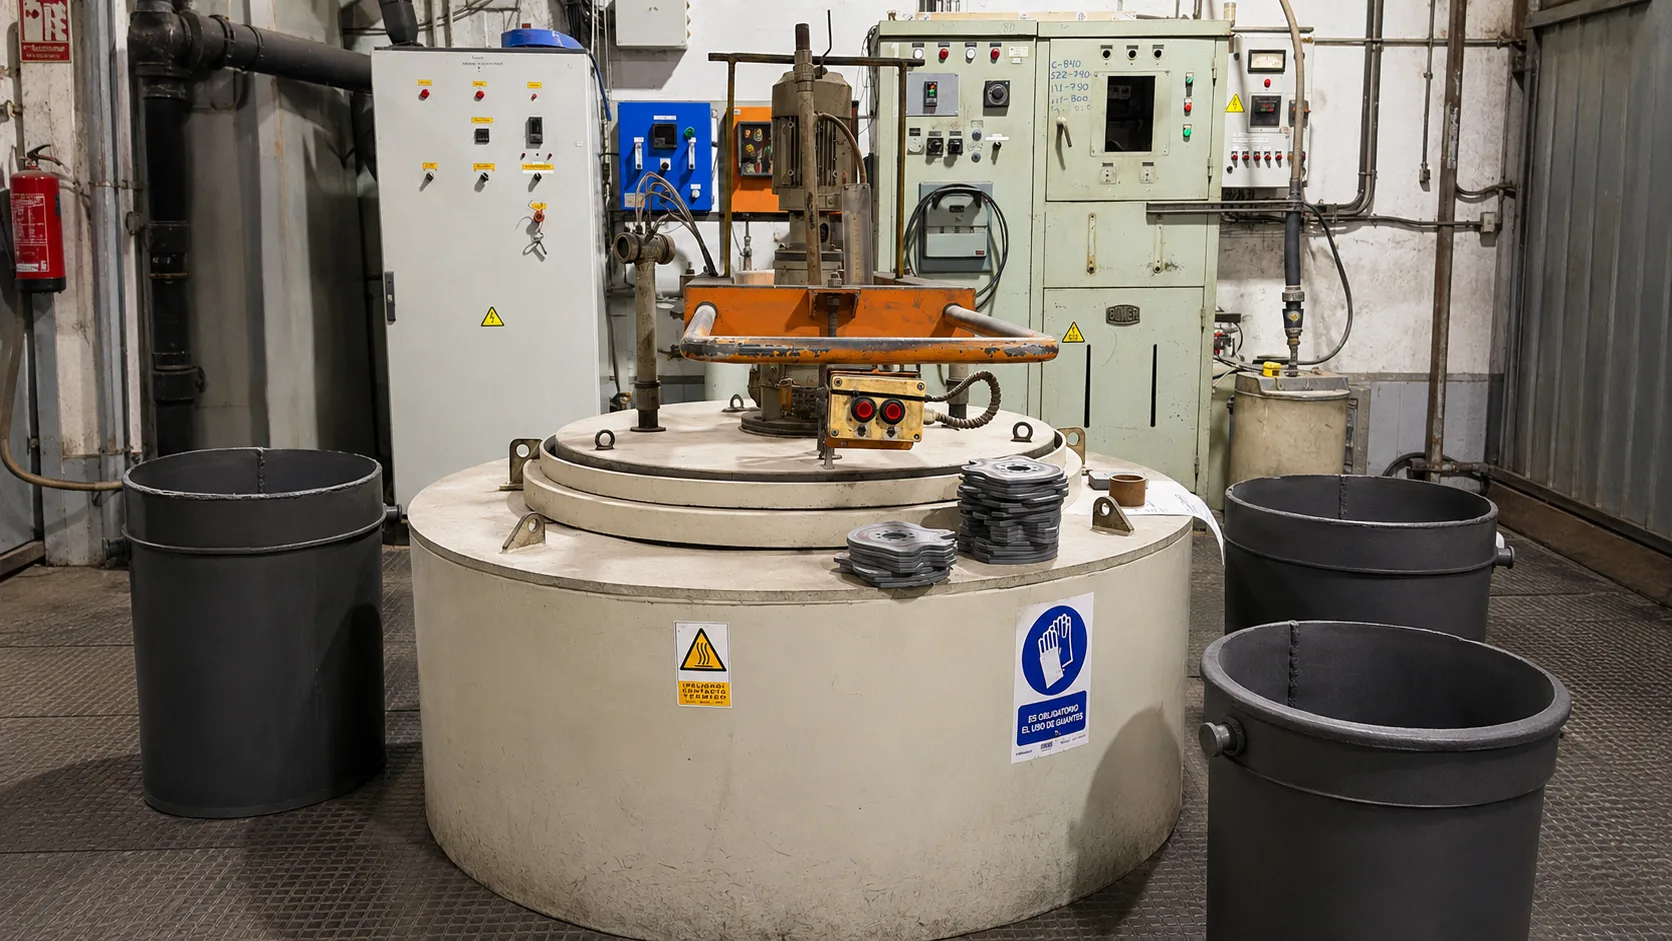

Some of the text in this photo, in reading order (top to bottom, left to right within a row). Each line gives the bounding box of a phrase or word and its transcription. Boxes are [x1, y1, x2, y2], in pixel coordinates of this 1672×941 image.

[1021, 712, 1084, 734] EL USO DE GUANTES
[1028, 714, 1037, 723] ES
